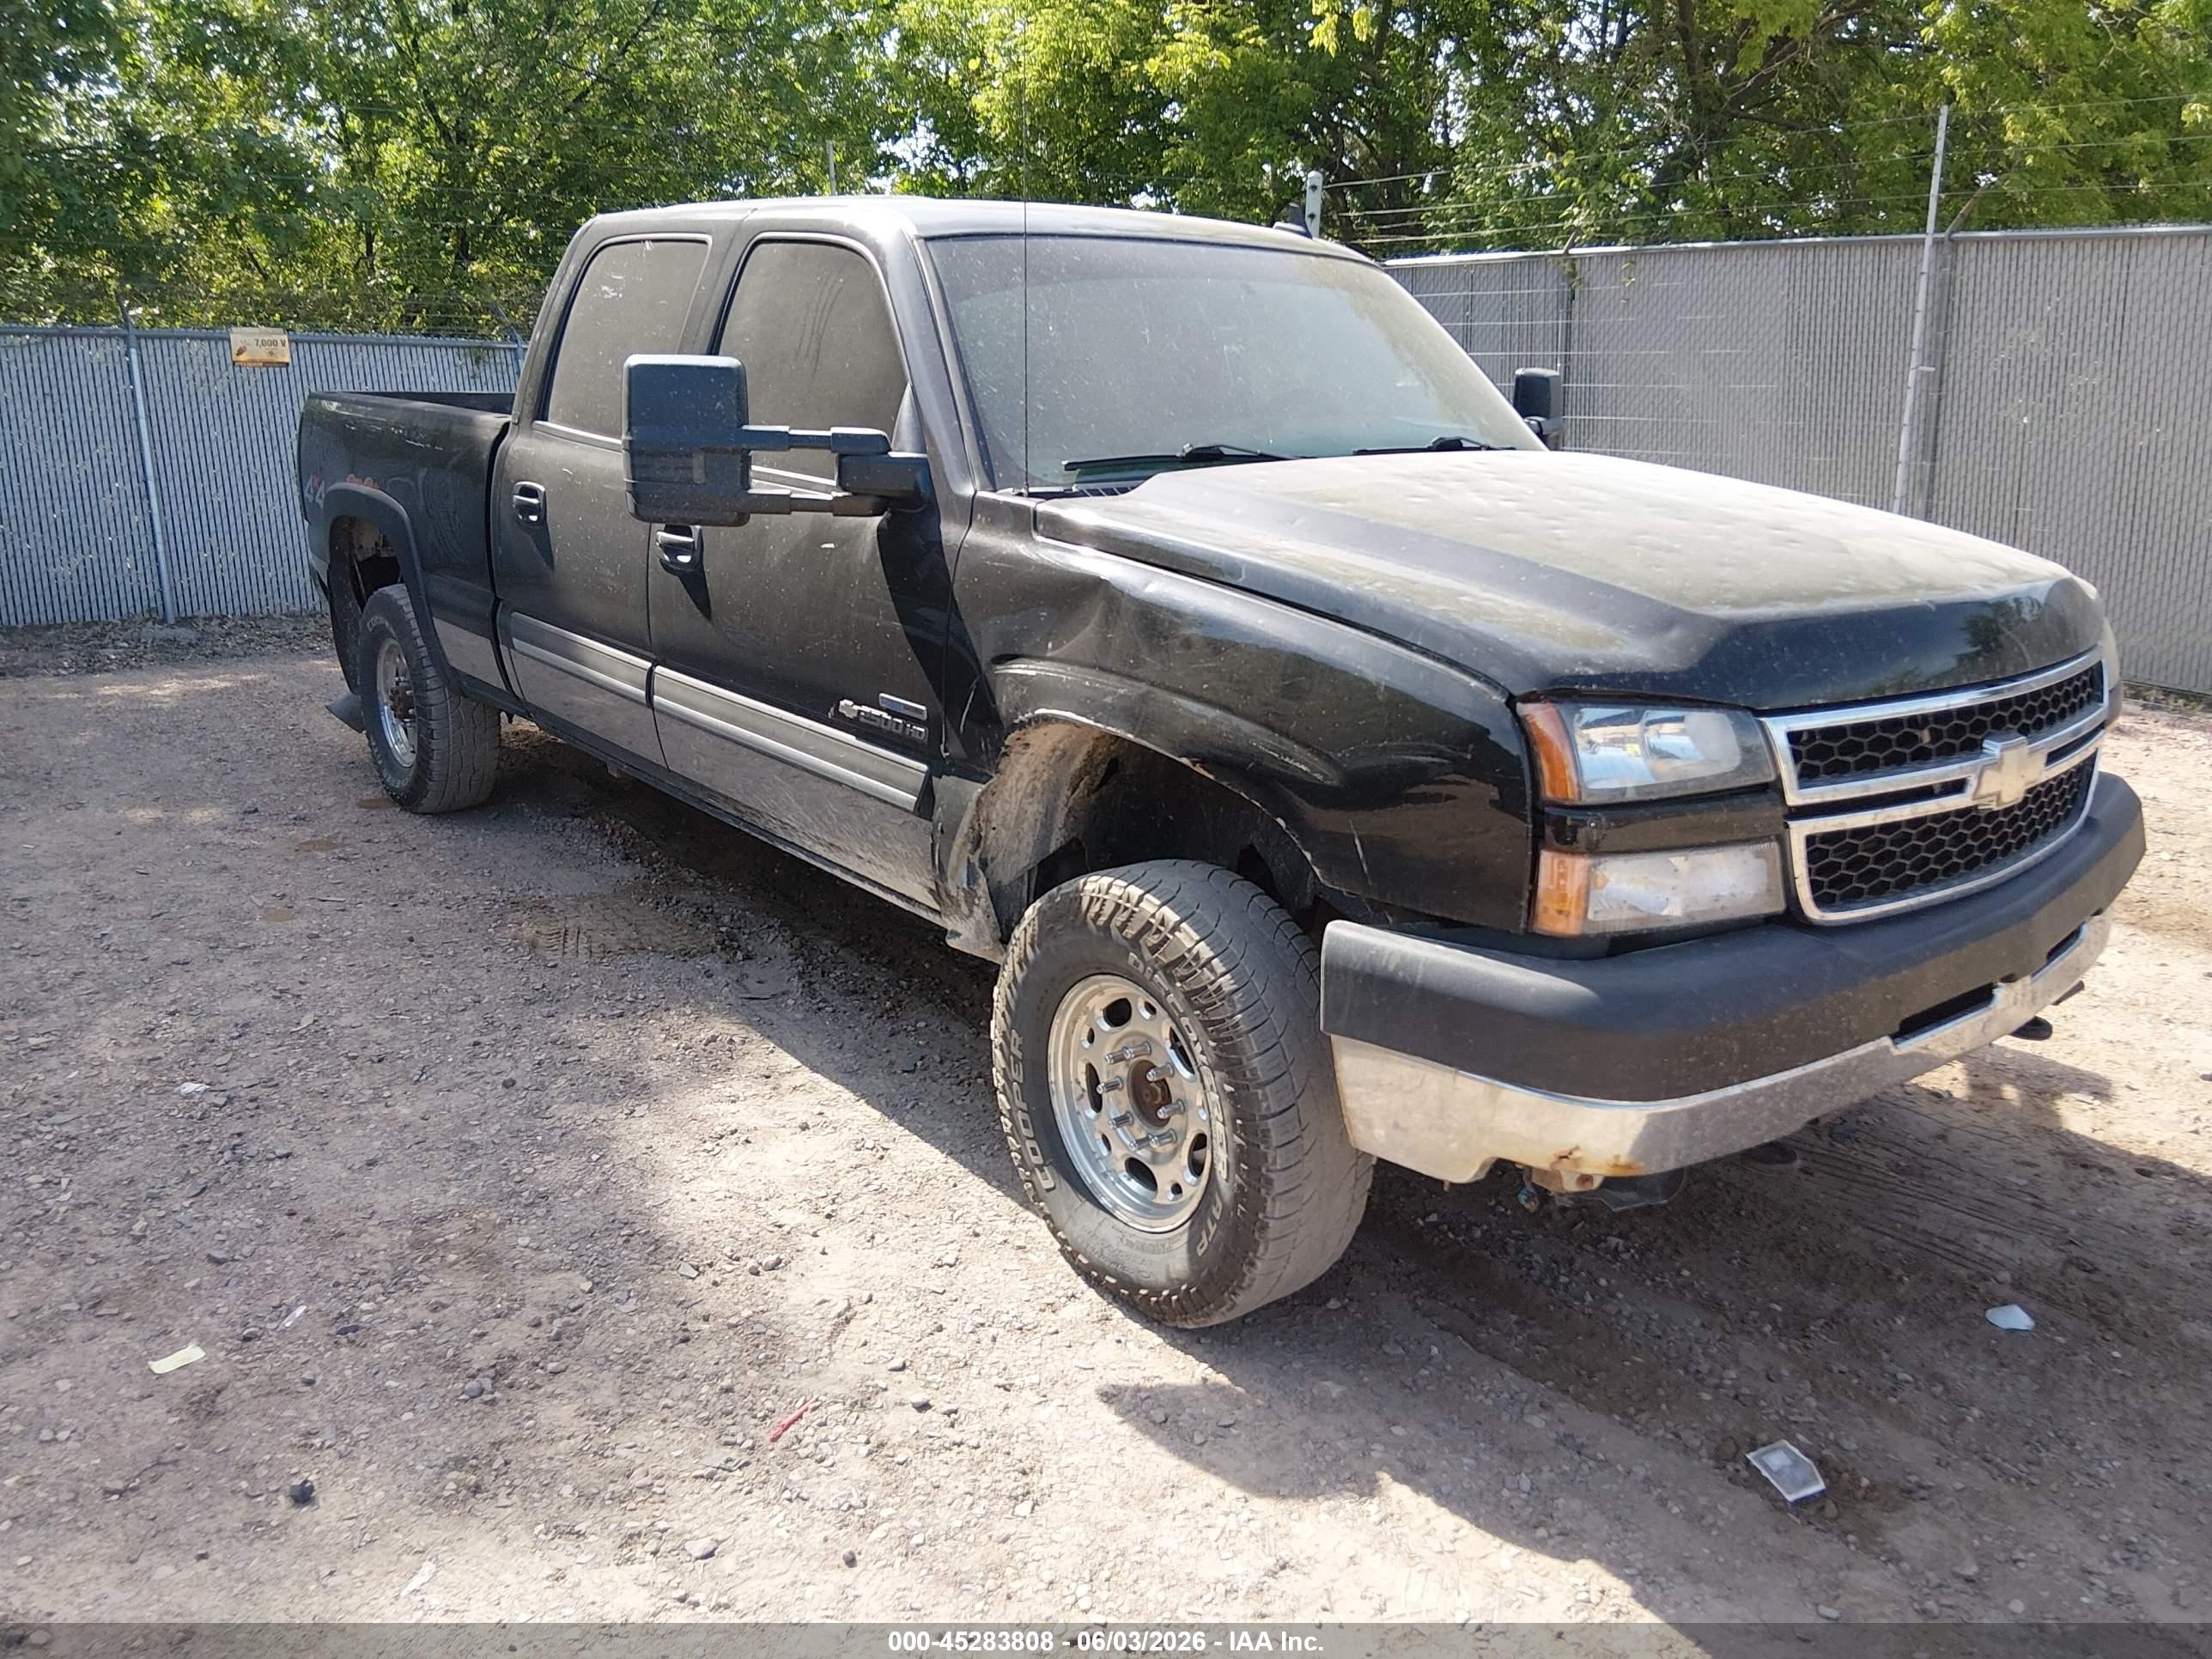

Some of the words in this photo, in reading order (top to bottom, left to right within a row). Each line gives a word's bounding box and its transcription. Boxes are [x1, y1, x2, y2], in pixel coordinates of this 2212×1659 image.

[254, 338, 278, 349] 7,000
[280, 338, 287, 348] V
[1010, 1029, 1055, 1190] COOPER
[1196, 1193, 1223, 1256] ATP
